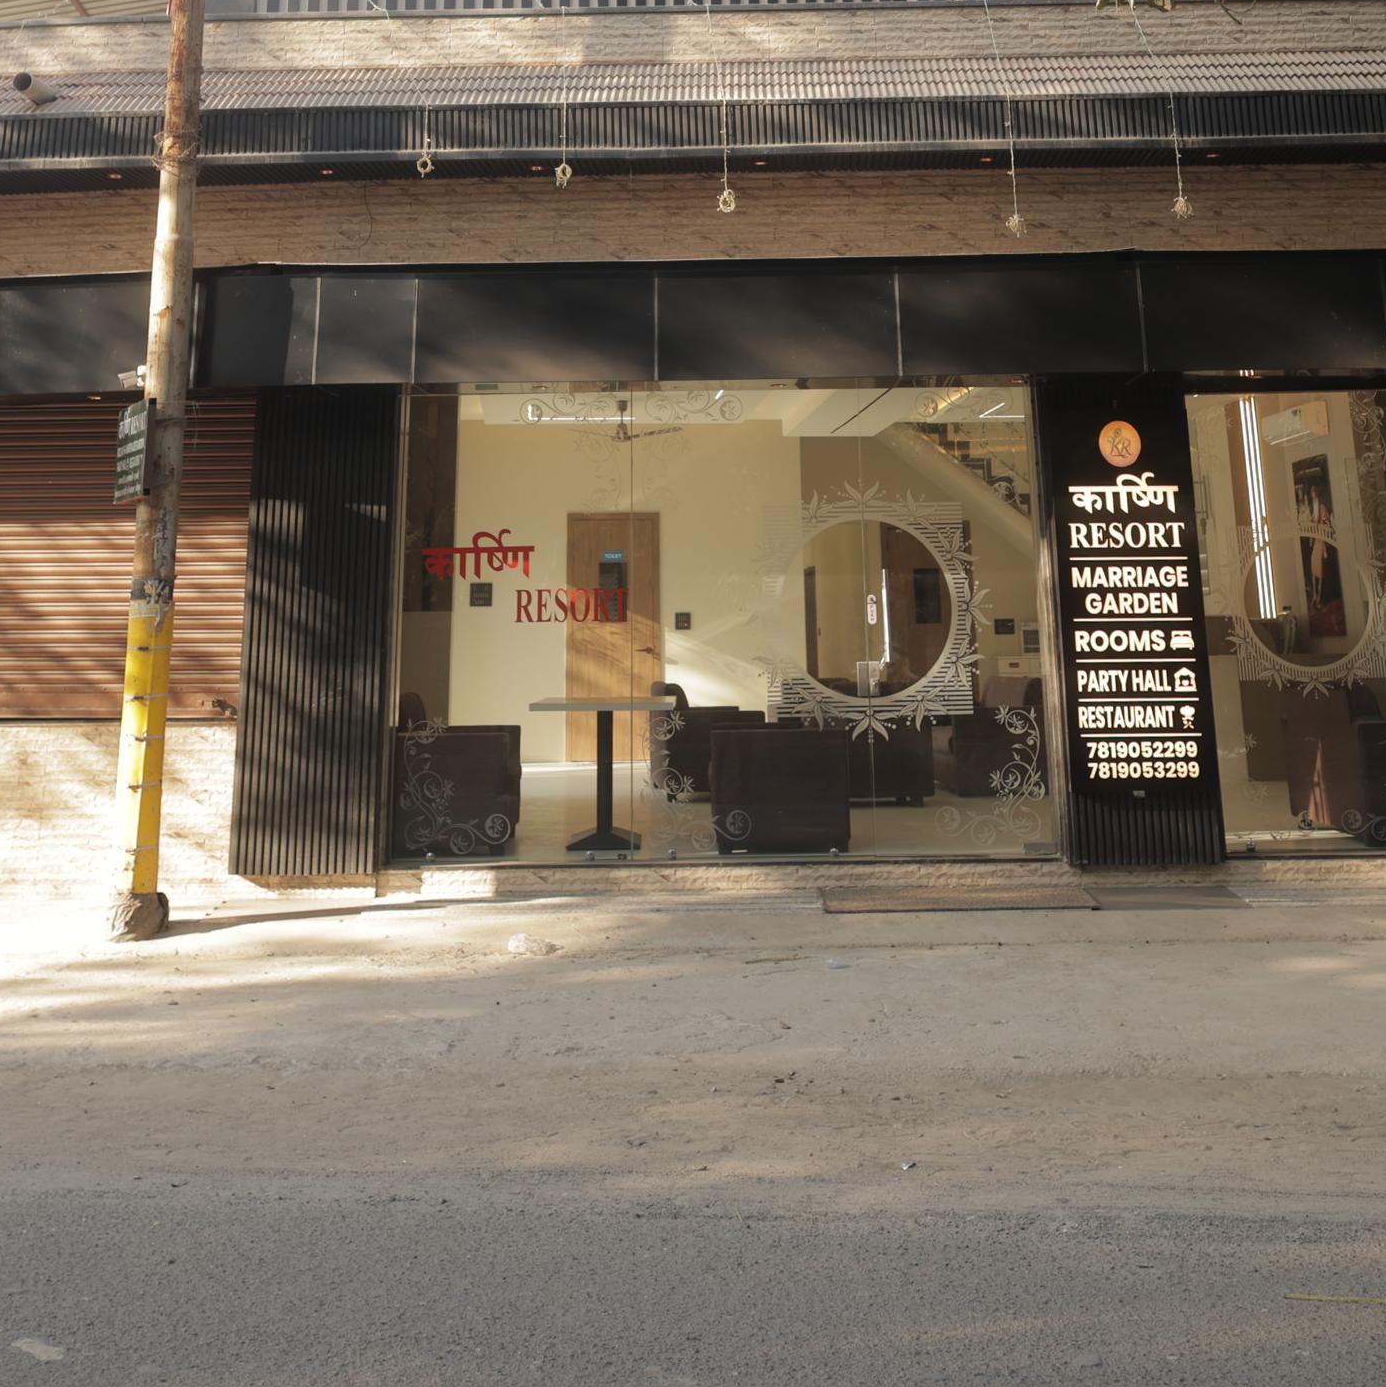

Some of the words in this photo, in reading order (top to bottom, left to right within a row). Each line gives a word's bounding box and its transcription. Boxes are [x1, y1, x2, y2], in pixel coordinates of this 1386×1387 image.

[1068, 472, 1179, 514] कार्ष्णि
[1068, 522, 1185, 549] RESORT
[1071, 566, 1189, 588] MARRIAGE
[515, 587, 629, 623] RESORT
[1085, 592, 1179, 614] GARDEN
[1074, 630, 1166, 652] ROOMS
[1077, 670, 1129, 692] PARTY
[1131, 669, 1172, 692] HALL
[1078, 705, 1175, 728] RESTAURANT
[1086, 741, 1198, 758] 7819052299
[1087, 761, 1200, 779] 7819053299
